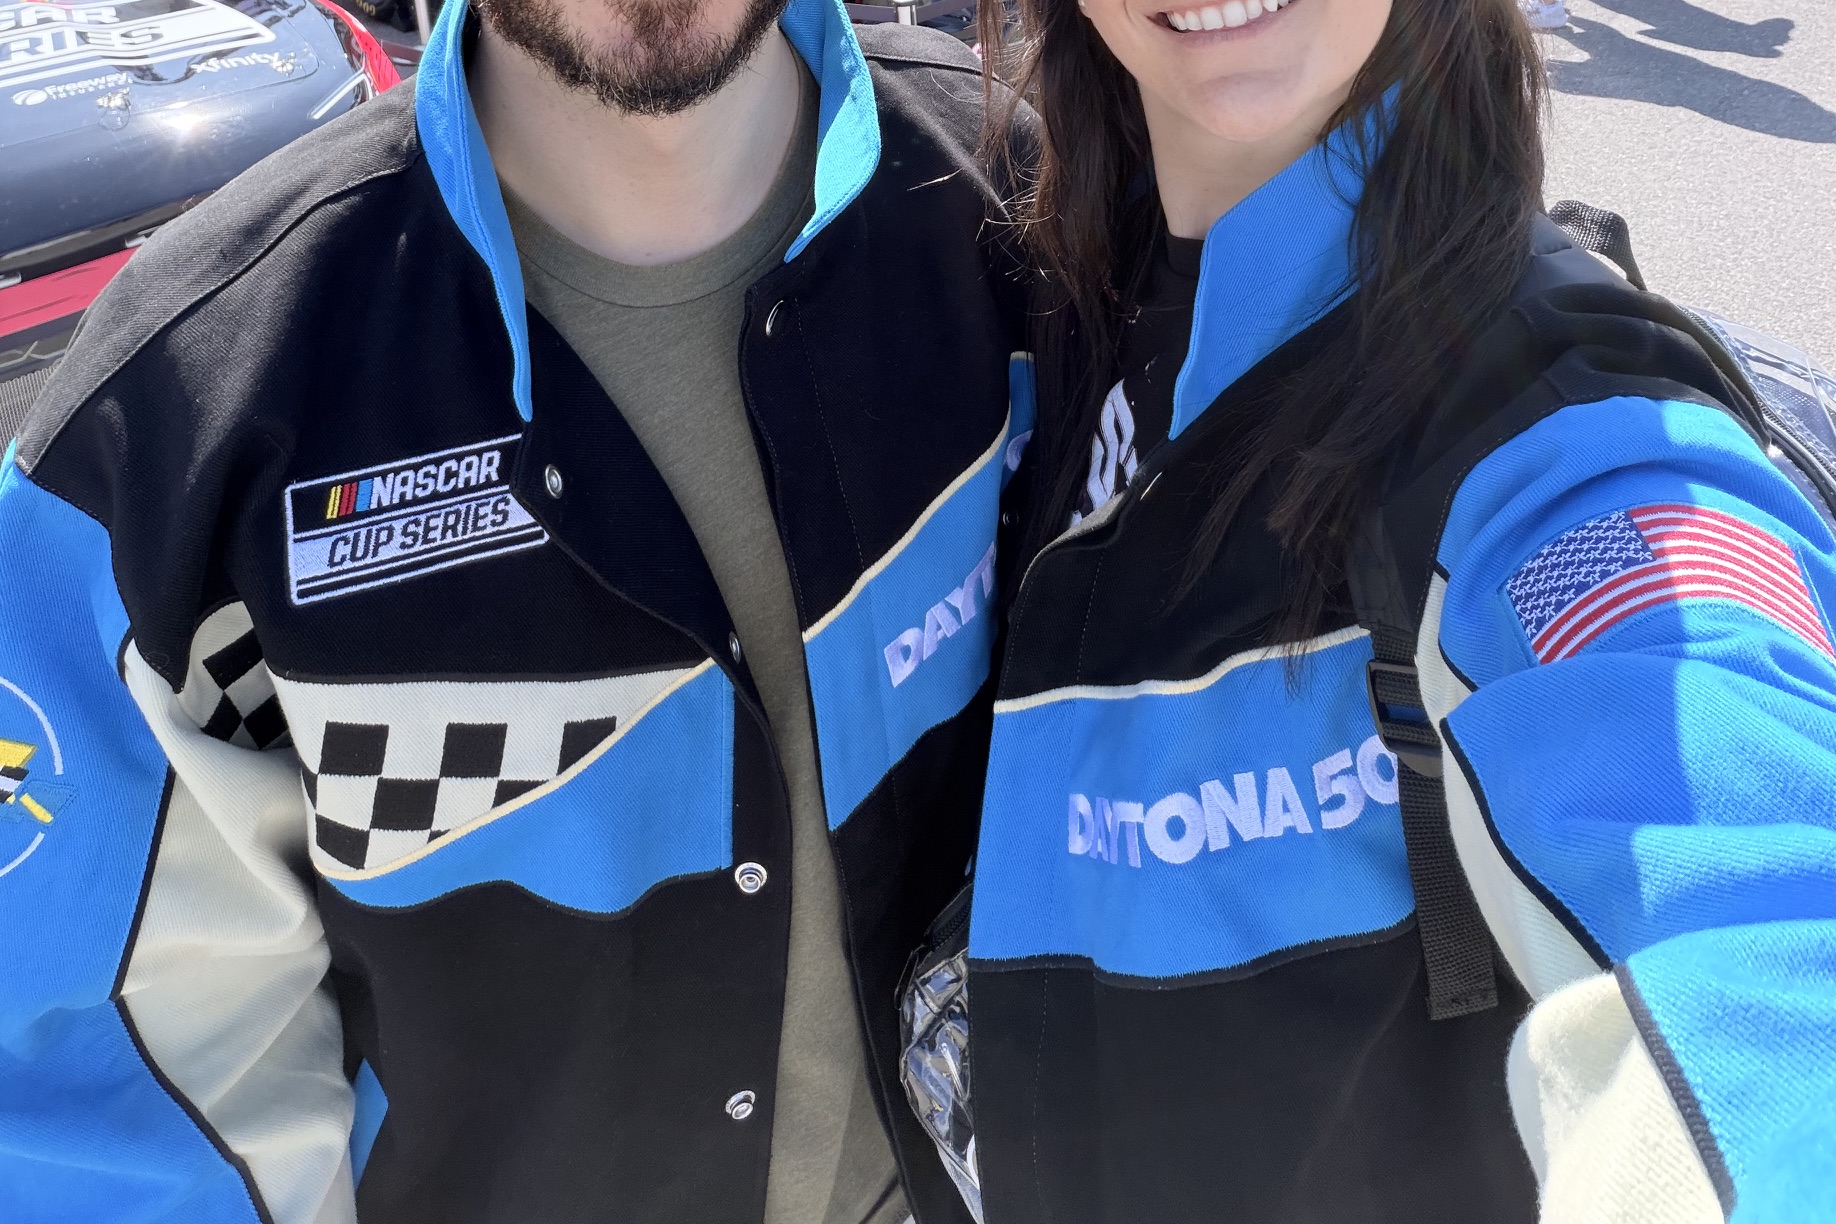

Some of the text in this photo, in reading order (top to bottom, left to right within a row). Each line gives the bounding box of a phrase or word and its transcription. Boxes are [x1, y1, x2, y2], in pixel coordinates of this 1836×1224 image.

[45, 72, 129, 96] Freeway
[190, 51, 281, 74] xfinity
[369, 450, 501, 510] NASCAR
[327, 495, 512, 568] CUP SERIES
[1068, 766, 1313, 868] DAYTONA
